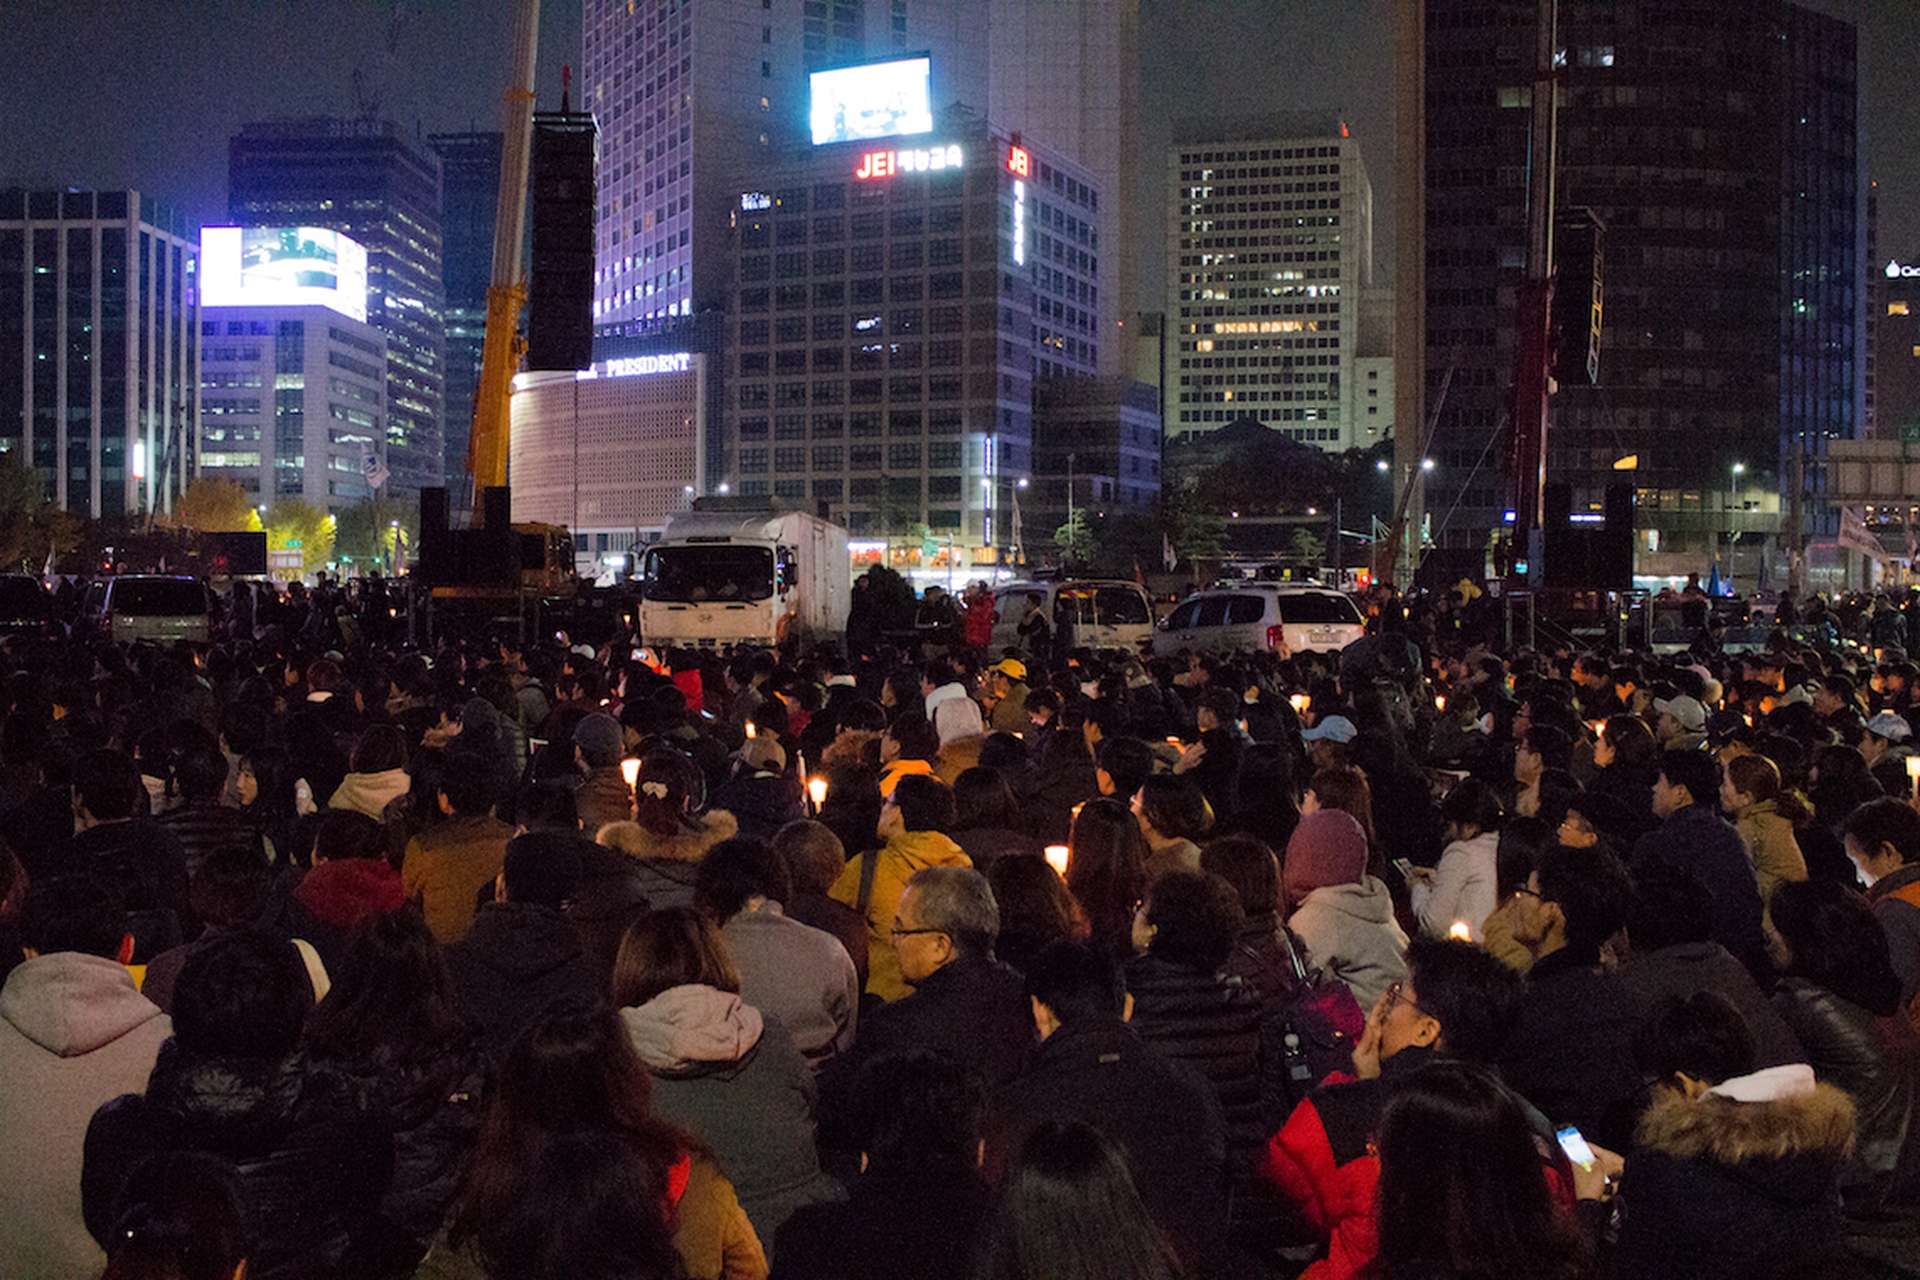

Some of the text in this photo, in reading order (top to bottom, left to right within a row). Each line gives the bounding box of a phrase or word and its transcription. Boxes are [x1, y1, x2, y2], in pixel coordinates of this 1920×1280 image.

[856, 151, 895, 179] JEI
[1007, 146, 1028, 177] JEI
[606, 352, 690, 378] PRESIDENT
